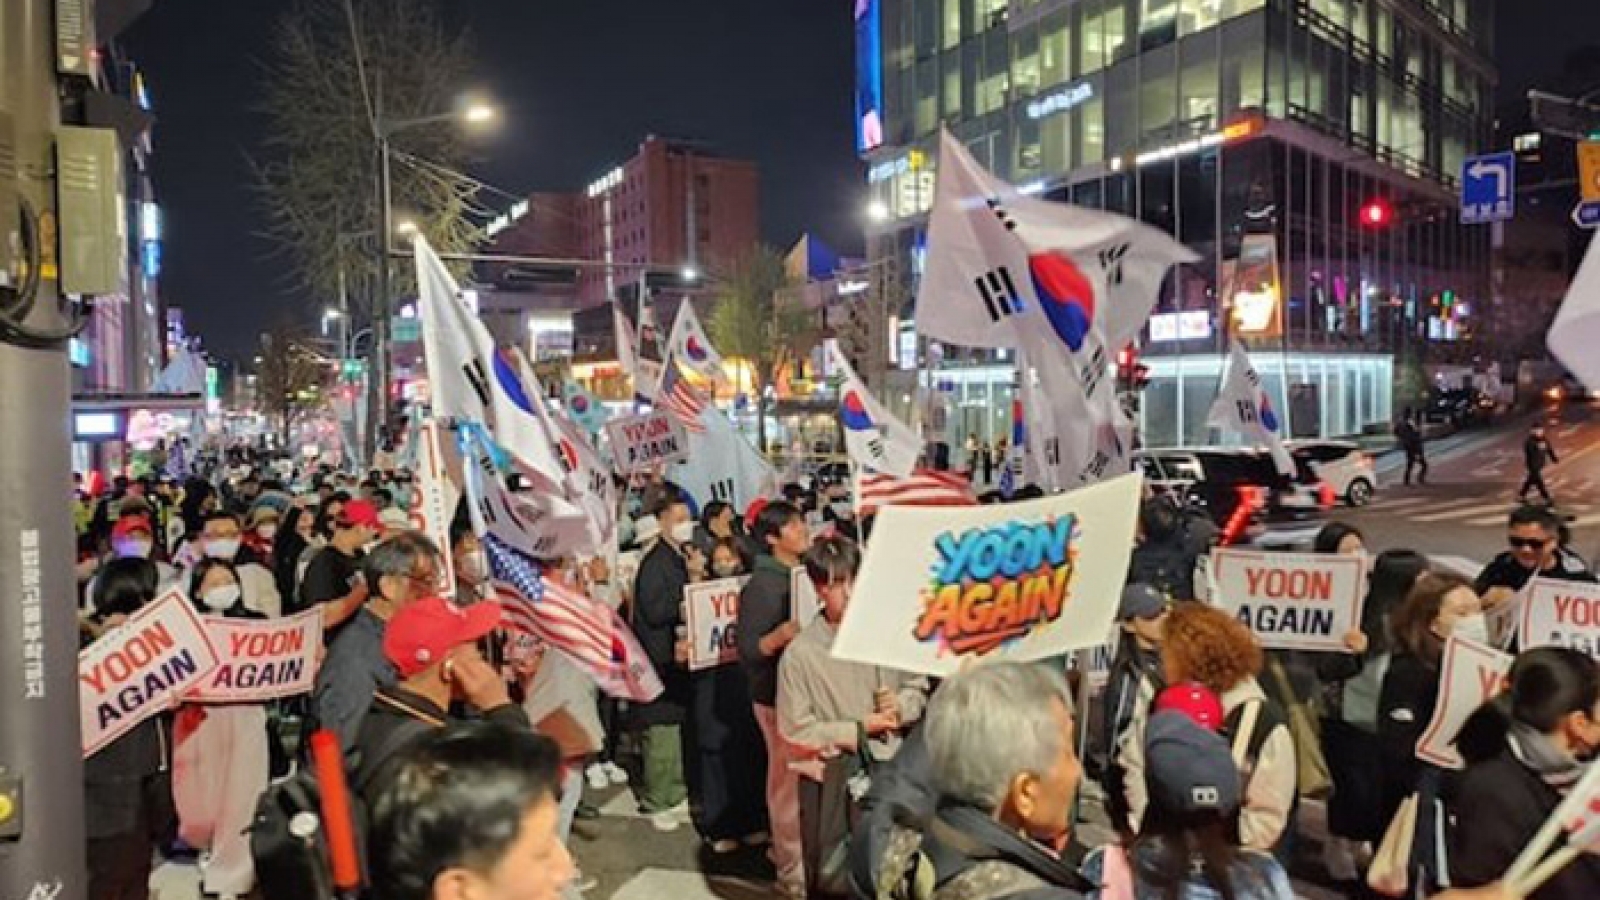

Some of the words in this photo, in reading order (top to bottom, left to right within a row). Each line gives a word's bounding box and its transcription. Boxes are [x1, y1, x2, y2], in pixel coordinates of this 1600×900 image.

[935, 512, 1077, 584] YOON
[912, 564, 1072, 642] AGAIN
[1246, 568, 1333, 600] YOON
[230, 628, 304, 657] YOON
[1237, 603, 1334, 635] AGAIN
[82, 620, 175, 694] YOON
[212, 657, 304, 688] AGAIN
[97, 648, 197, 730] AGAIN
